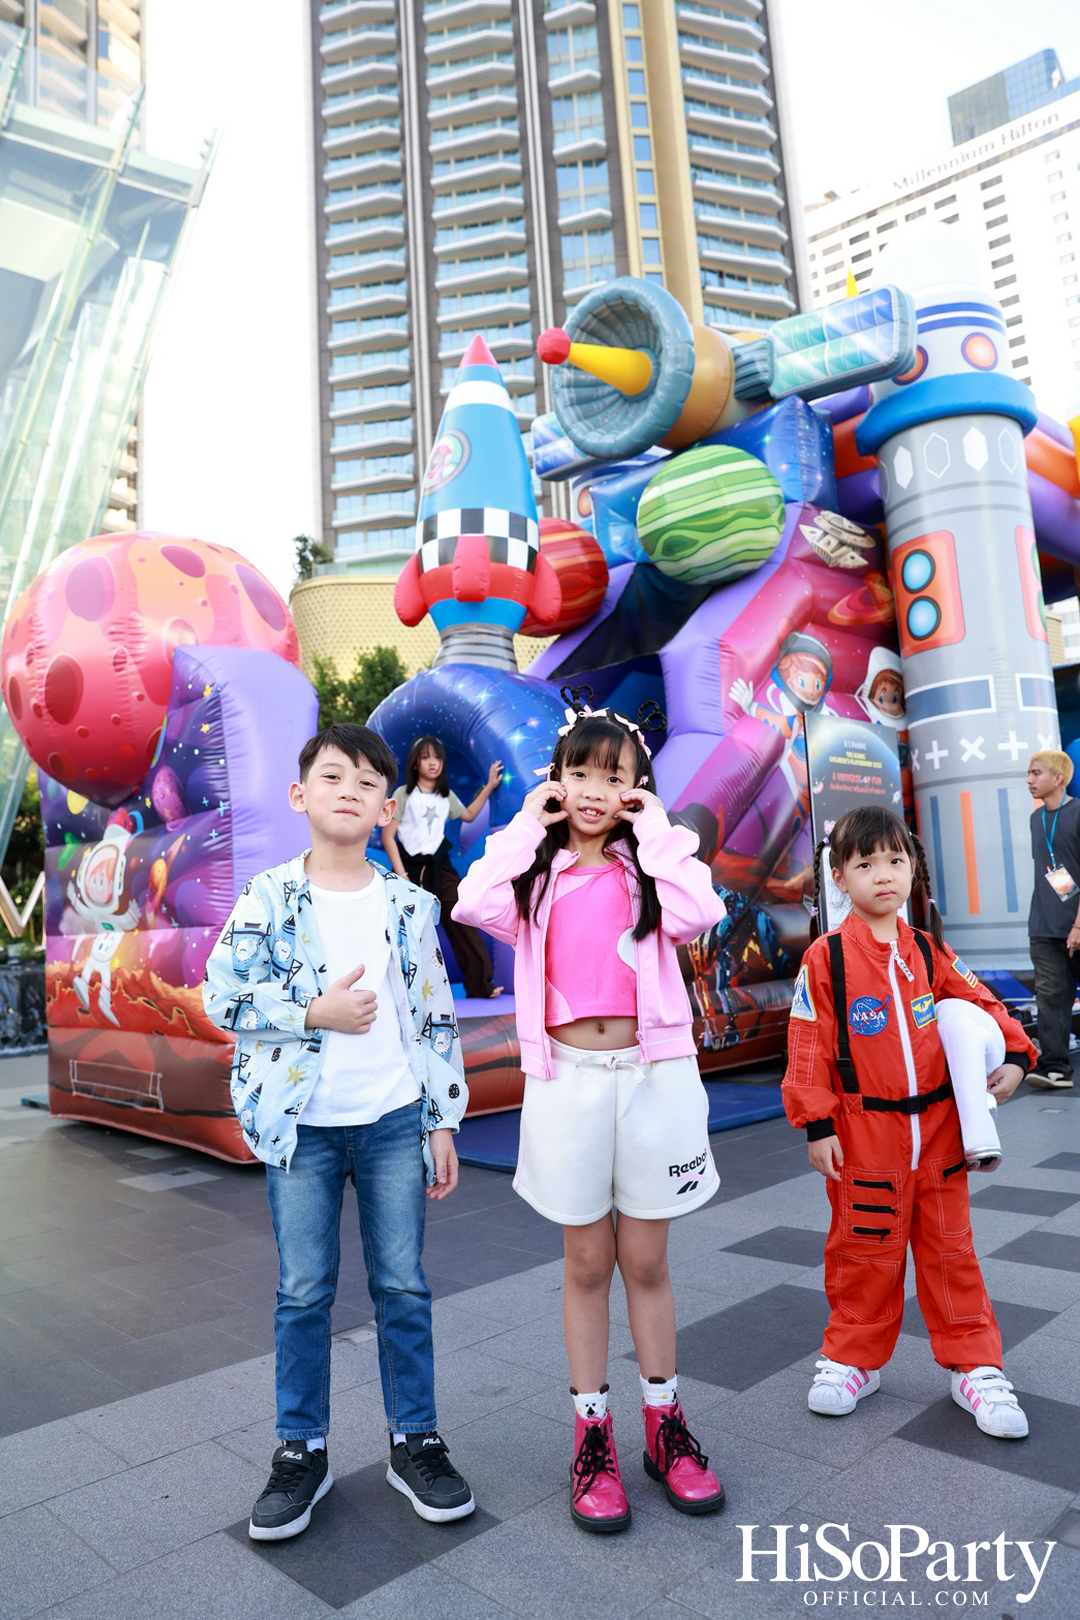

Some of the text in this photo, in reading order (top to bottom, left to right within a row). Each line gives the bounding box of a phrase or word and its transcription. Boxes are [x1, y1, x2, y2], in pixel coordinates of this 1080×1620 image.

[893, 113, 1059, 190] Millennium Hilton
[852, 1010, 886, 1023] NASA
[669, 1148, 707, 1177] Reebo
[422, 1437, 441, 1447] FILA
[281, 1450, 302, 1460] FILA
